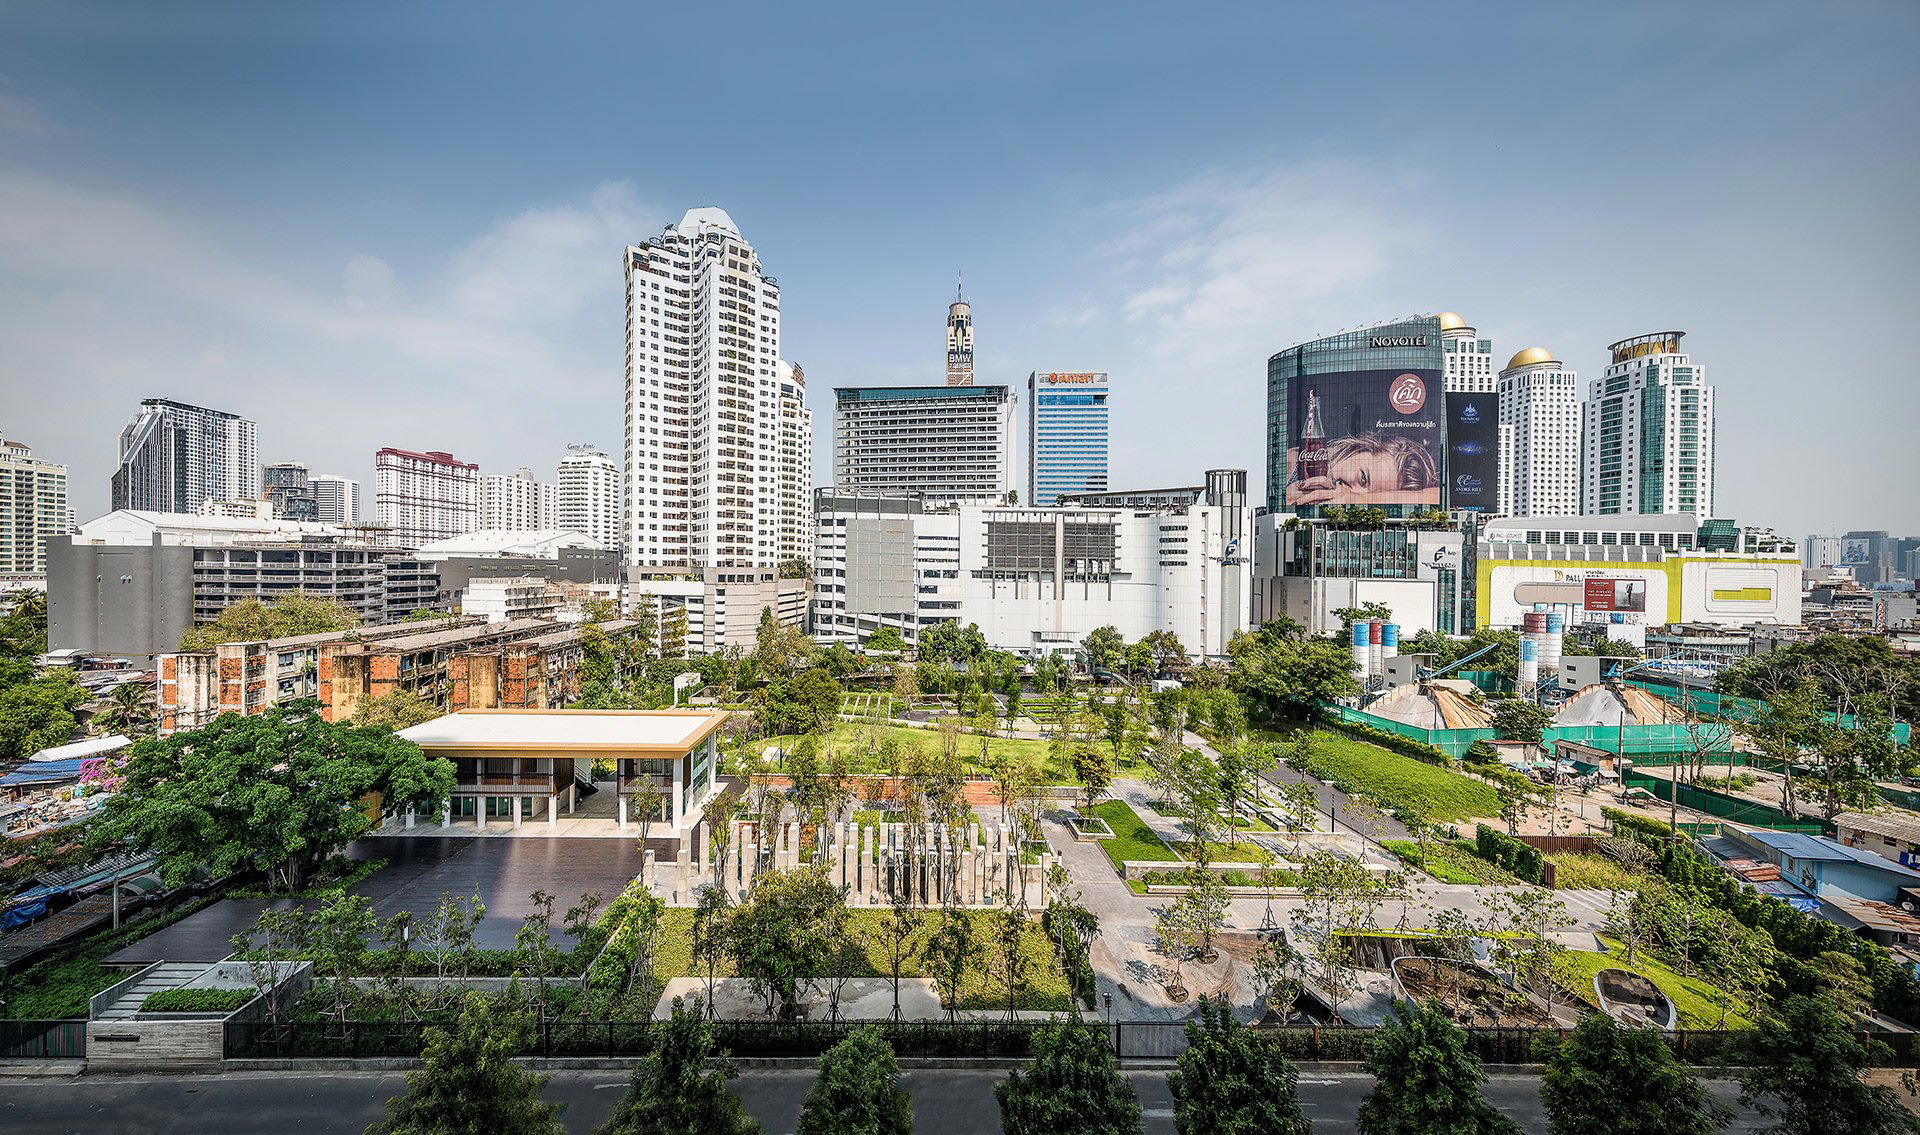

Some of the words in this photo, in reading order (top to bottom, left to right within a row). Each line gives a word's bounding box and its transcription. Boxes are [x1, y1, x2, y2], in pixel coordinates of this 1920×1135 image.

[1371, 336, 1426, 347] NOVOTEL
[949, 353, 972, 363] BMW
[1059, 372, 1094, 383] Amari
